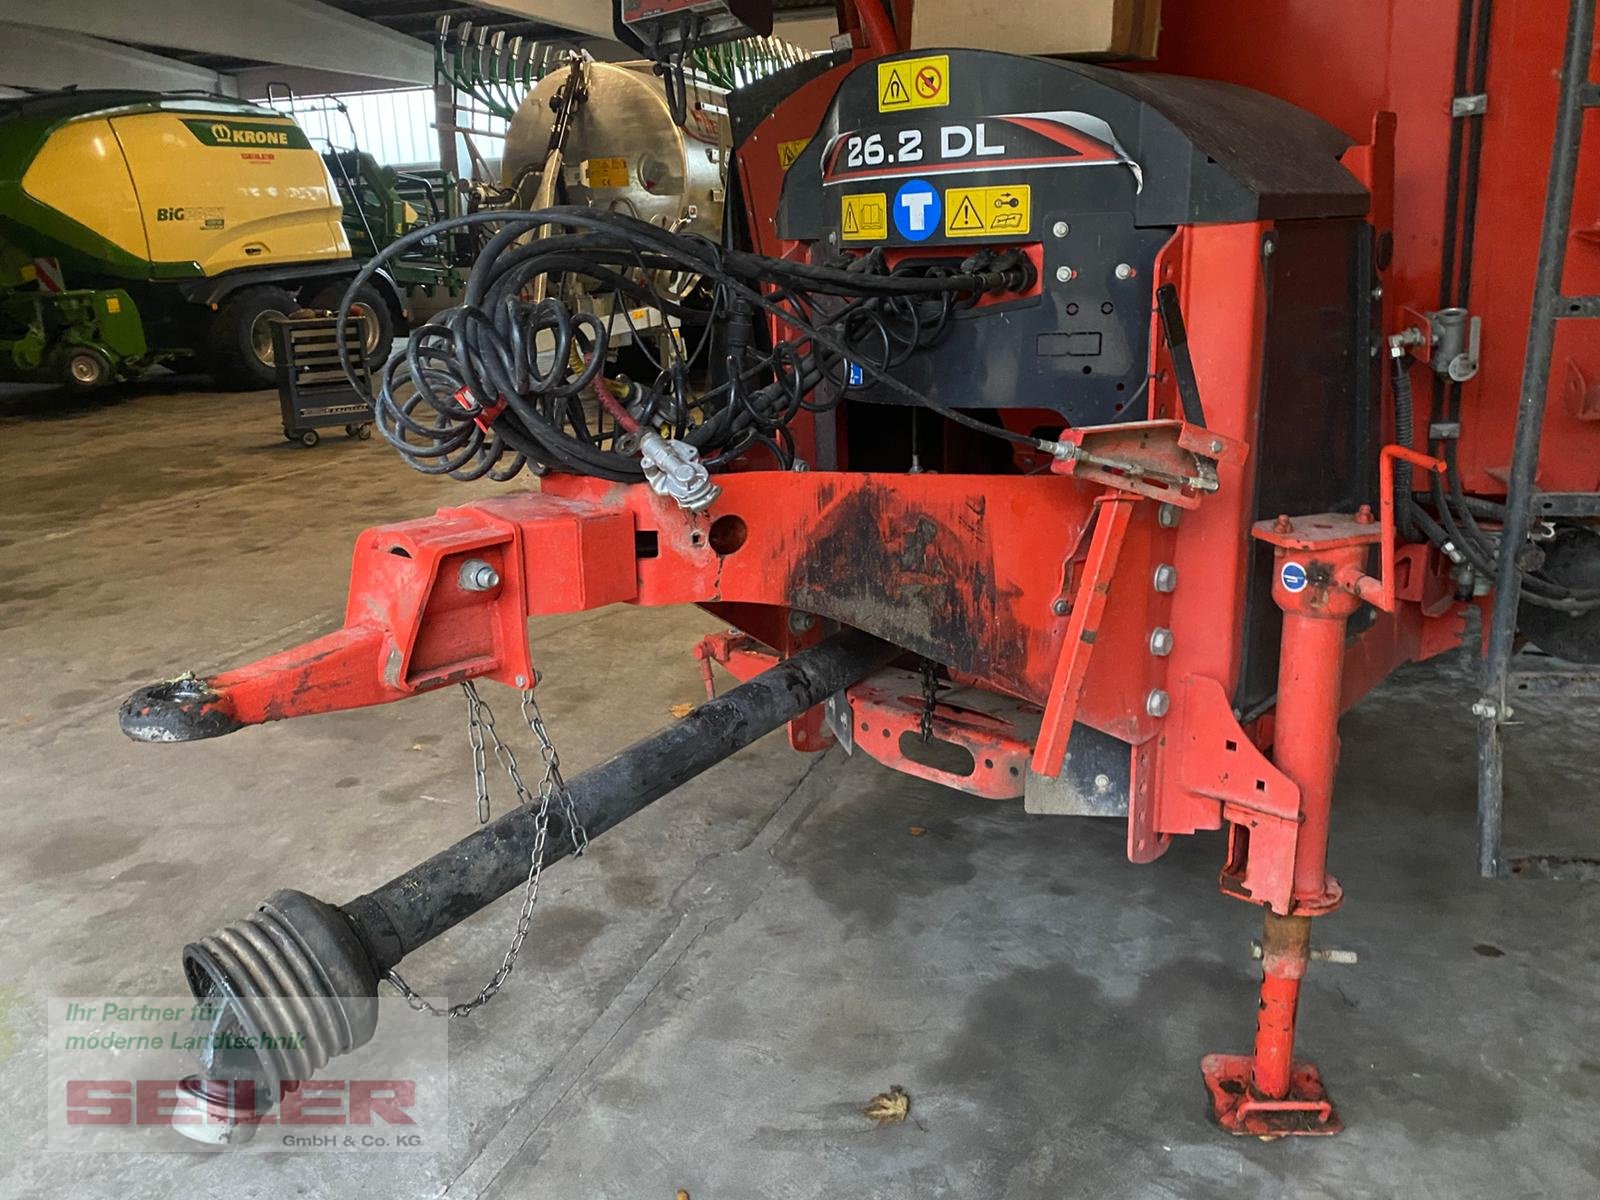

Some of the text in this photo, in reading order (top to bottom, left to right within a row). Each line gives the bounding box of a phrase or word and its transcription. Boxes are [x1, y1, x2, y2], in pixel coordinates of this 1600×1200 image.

[233, 130, 288, 145] KRONE
[847, 123, 1005, 168] 26.2 DL
